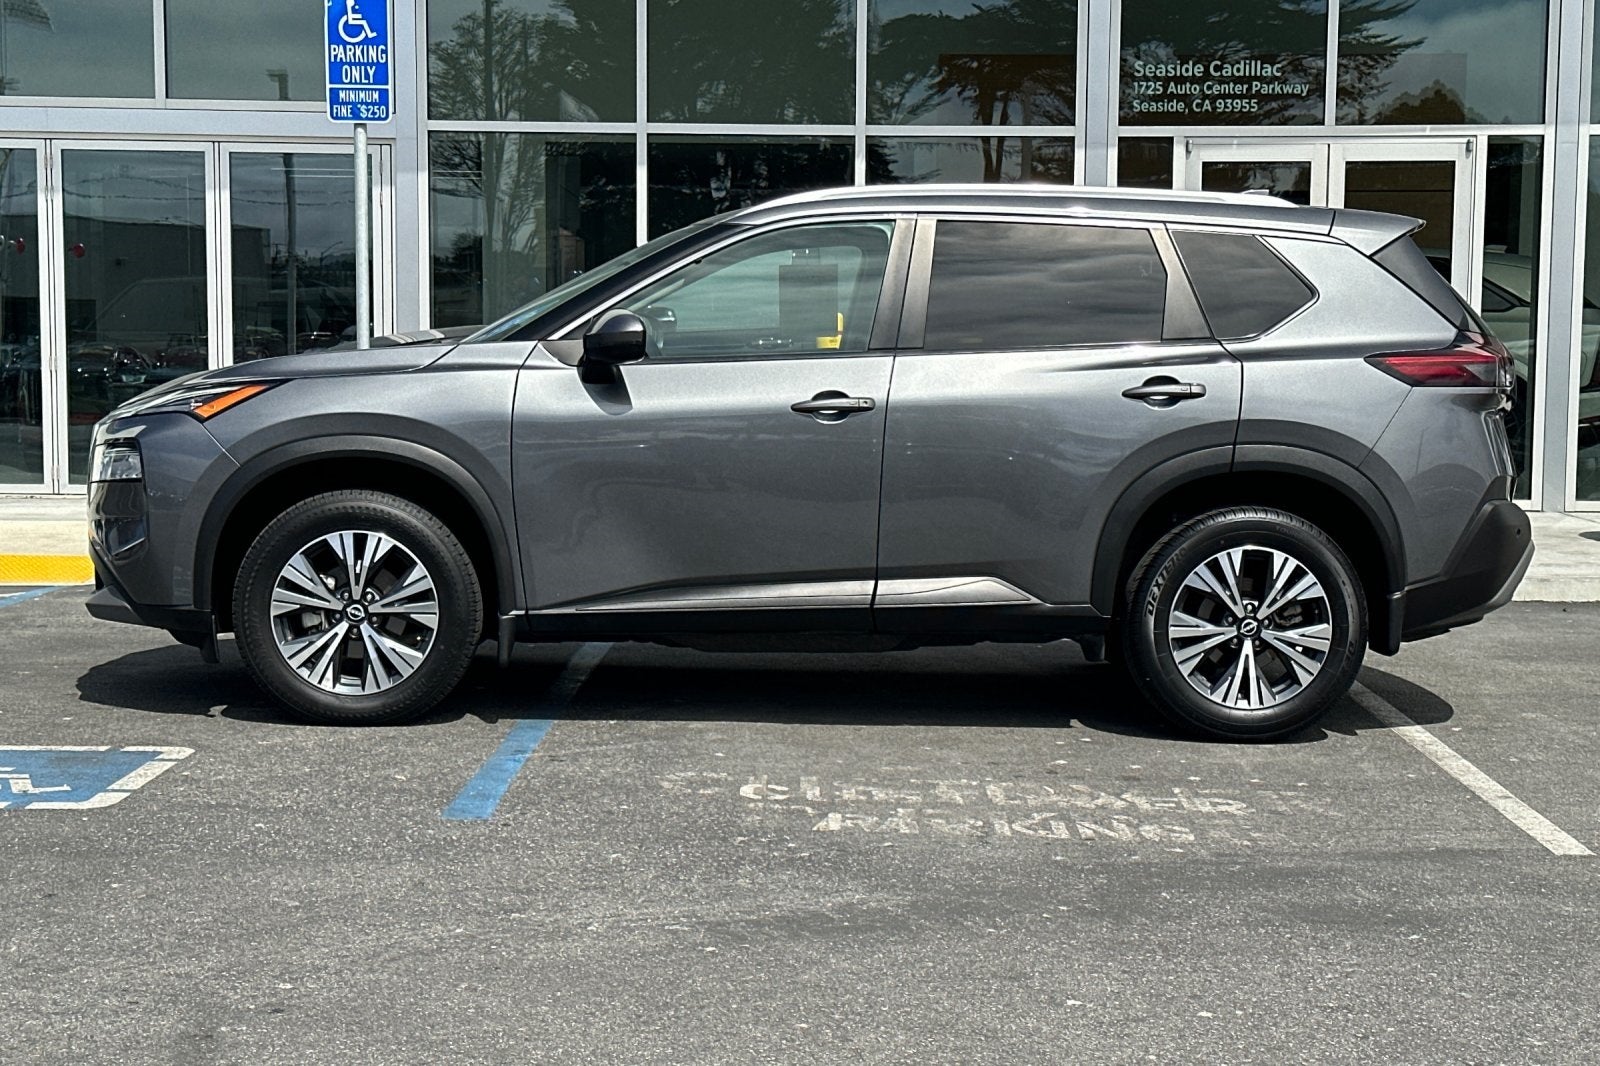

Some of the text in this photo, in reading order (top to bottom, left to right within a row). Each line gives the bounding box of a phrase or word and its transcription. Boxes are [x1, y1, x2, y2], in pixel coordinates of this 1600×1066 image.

[330, 44, 387, 63] PARKING
[342, 64, 376, 83] ONLY
[1133, 60, 1283, 77] Seaside Cadillac
[339, 90, 380, 103] MINIMUM
[1133, 81, 1310, 97] 1725 Auto Center Parkway
[333, 104, 387, 119] FINE $250
[1132, 99, 1259, 115] Seaside, CA 93955
